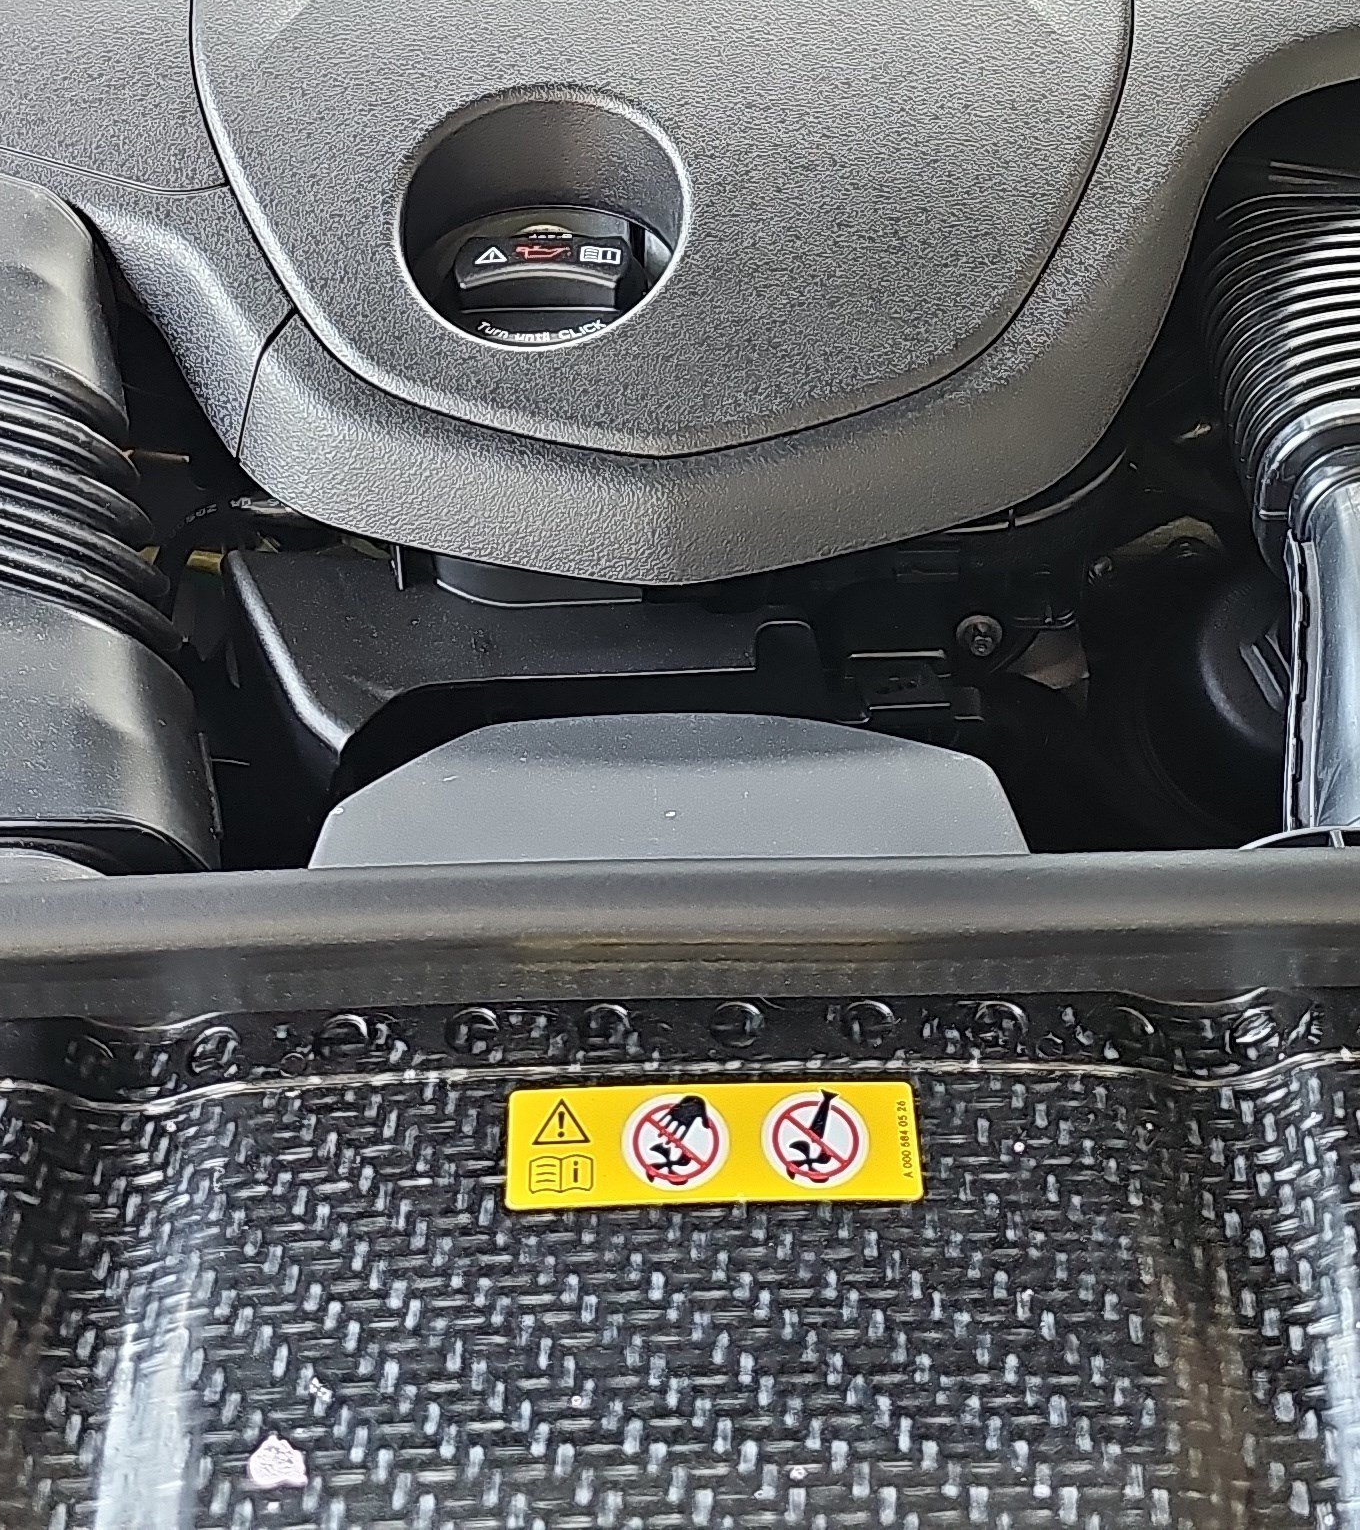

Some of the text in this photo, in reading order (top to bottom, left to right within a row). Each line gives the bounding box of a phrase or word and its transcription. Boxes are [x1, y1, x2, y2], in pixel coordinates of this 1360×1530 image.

[475, 320, 510, 340] Turn
[557, 318, 608, 339] CLICK
[896, 1100, 908, 1113] 26
[897, 1114, 909, 1128] 05
[901, 1149, 913, 1169] 000
[903, 1171, 914, 1179] A
